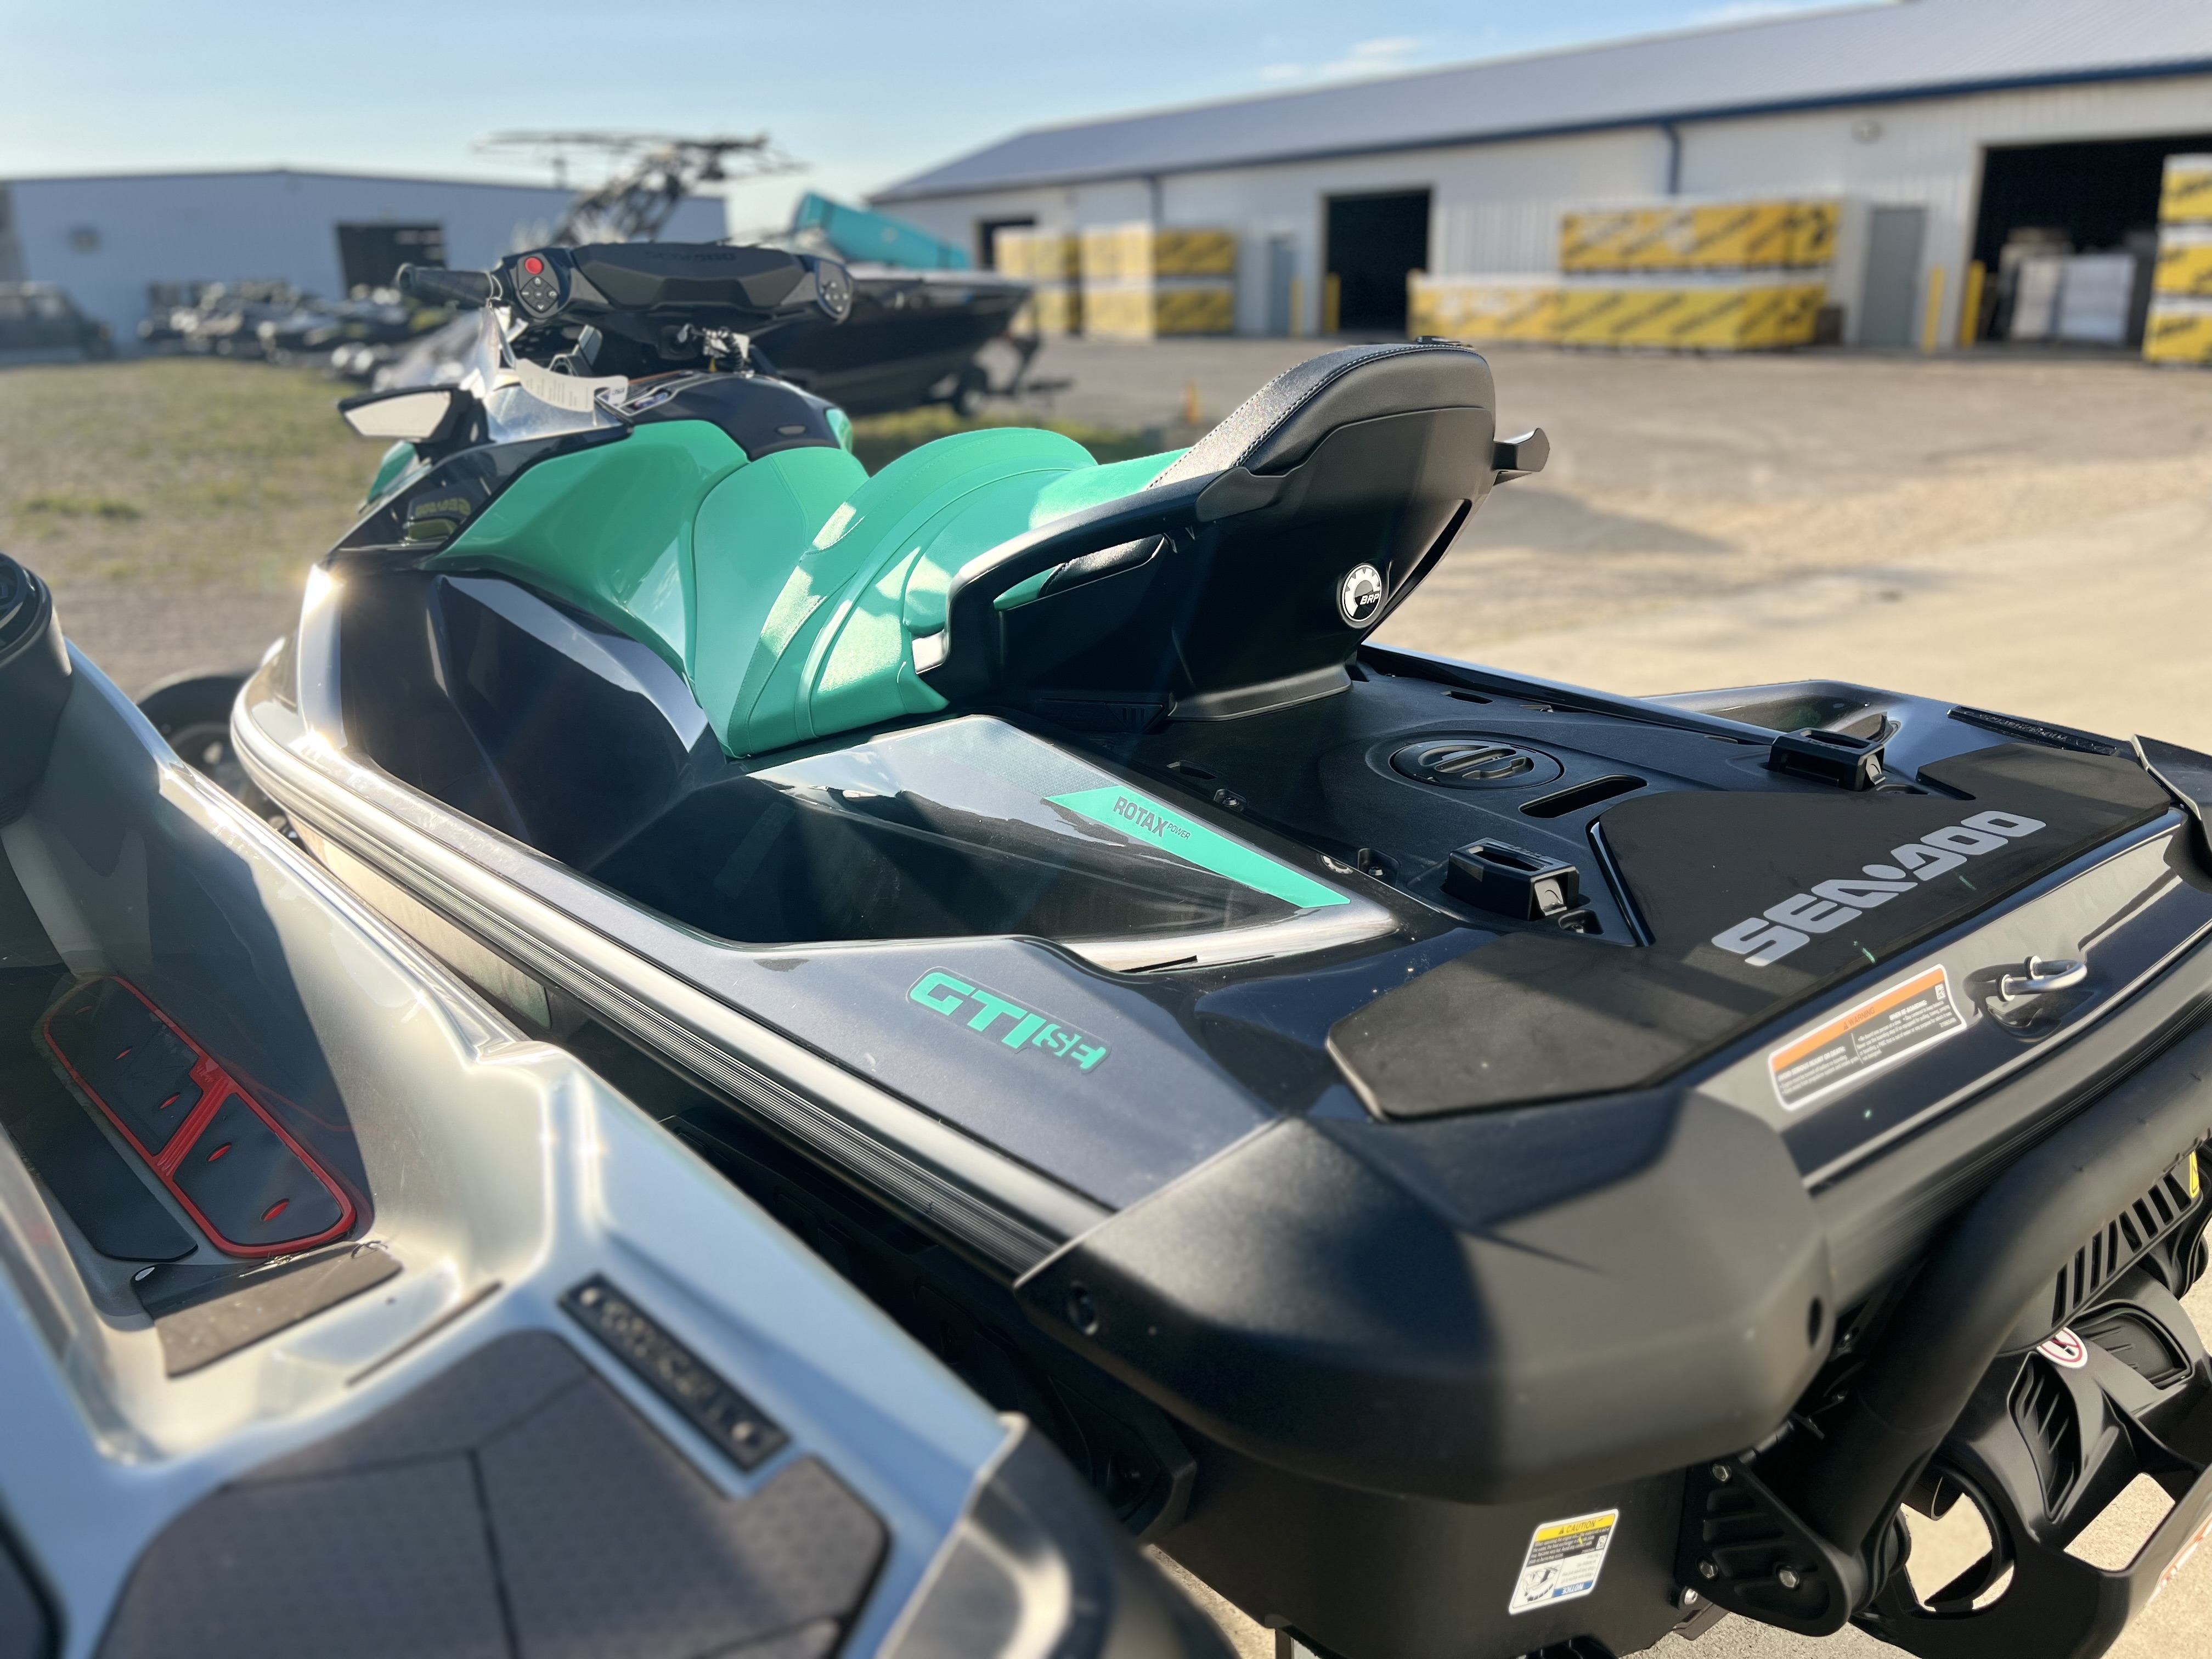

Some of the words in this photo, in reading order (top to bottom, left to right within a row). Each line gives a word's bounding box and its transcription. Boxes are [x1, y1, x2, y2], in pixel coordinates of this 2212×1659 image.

[1359, 592, 1380, 605] BRP
[1113, 796, 1169, 837] ROTAX
[1166, 823, 1191, 840] POWER
[910, 972, 1047, 1049] GTI
[1848, 1006, 1875, 1027] WARNING
[1566, 1519, 1596, 1533] CAUTION
[1561, 1583, 1584, 1595] NOTICE
